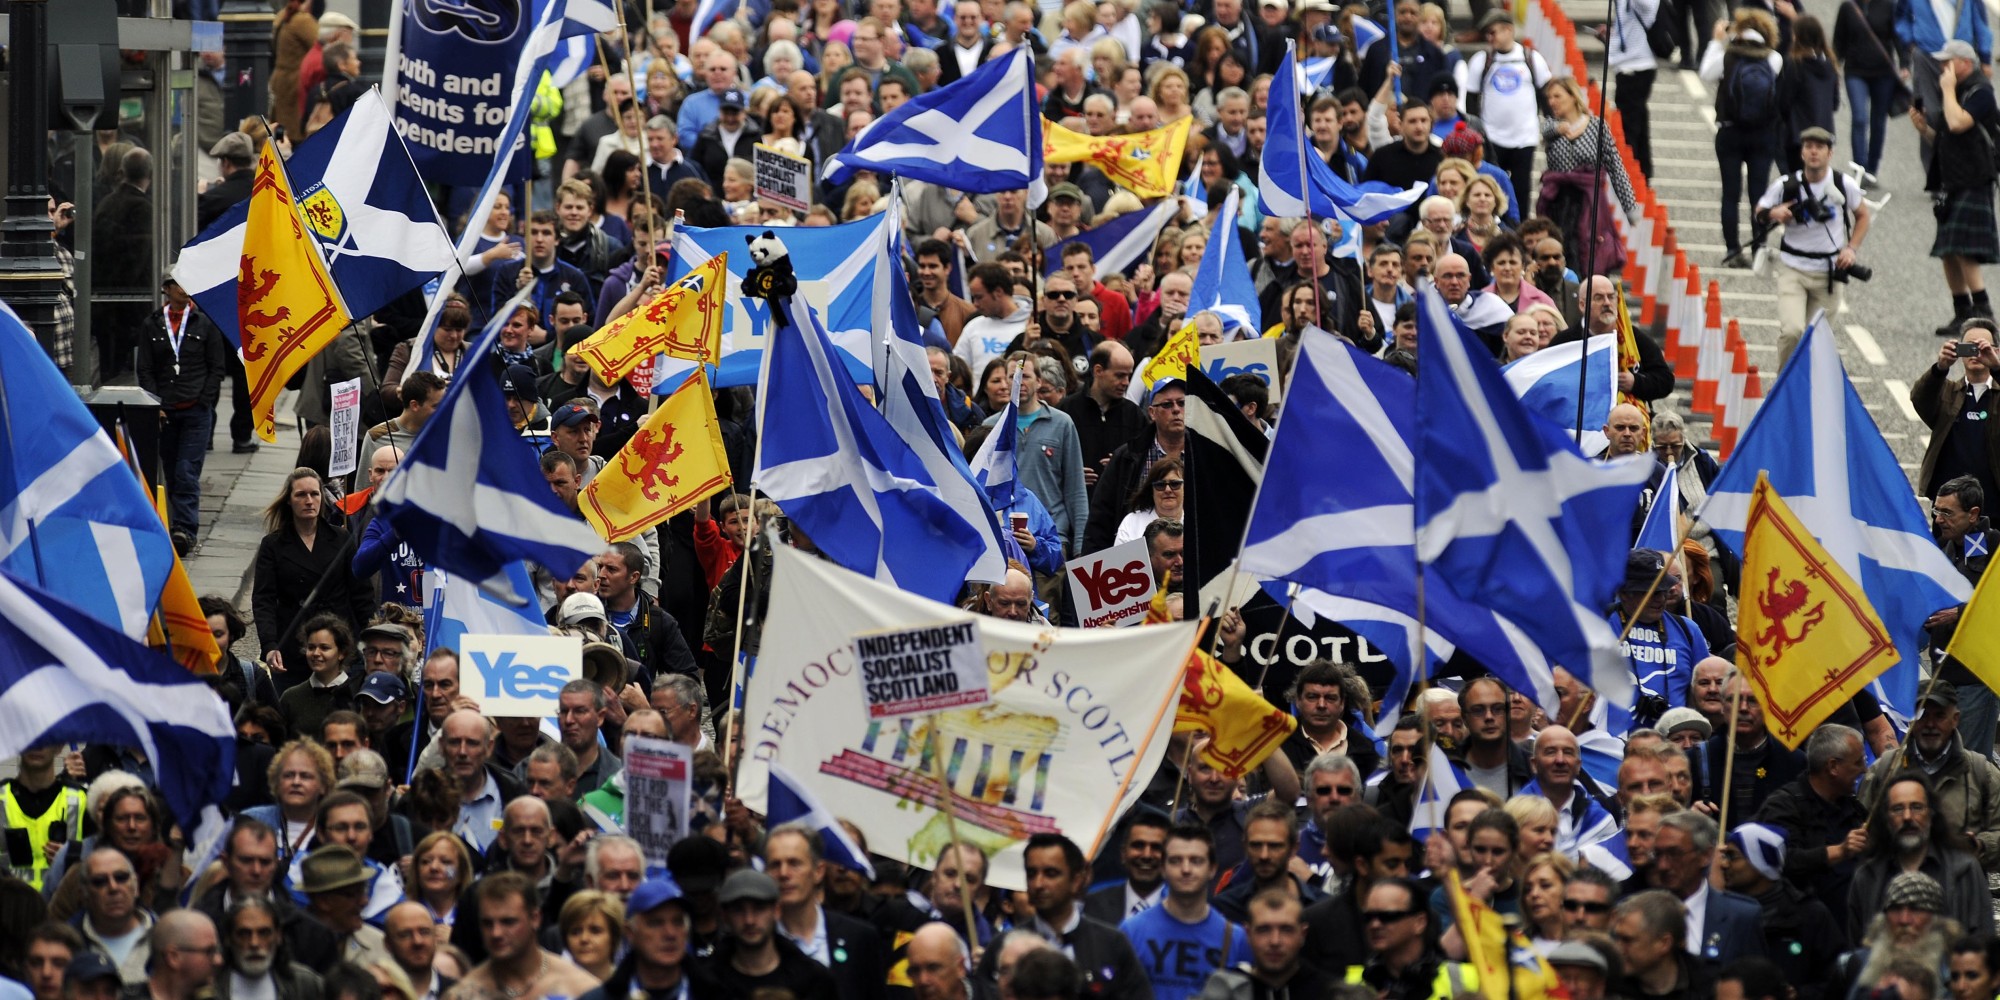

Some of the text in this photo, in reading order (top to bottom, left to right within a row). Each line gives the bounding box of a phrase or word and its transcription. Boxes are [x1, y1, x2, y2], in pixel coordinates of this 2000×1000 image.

[442, 72, 501, 96] and
[397, 83, 464, 124] dents
[1072, 560, 1150, 611] Yes
[858, 623, 974, 659] INDEPENDENT
[468, 651, 571, 700] Yes
[862, 649, 952, 682] SOCIALIST
[753, 645, 855, 761] DEMOC
[866, 672, 959, 704] SCOTLAND
